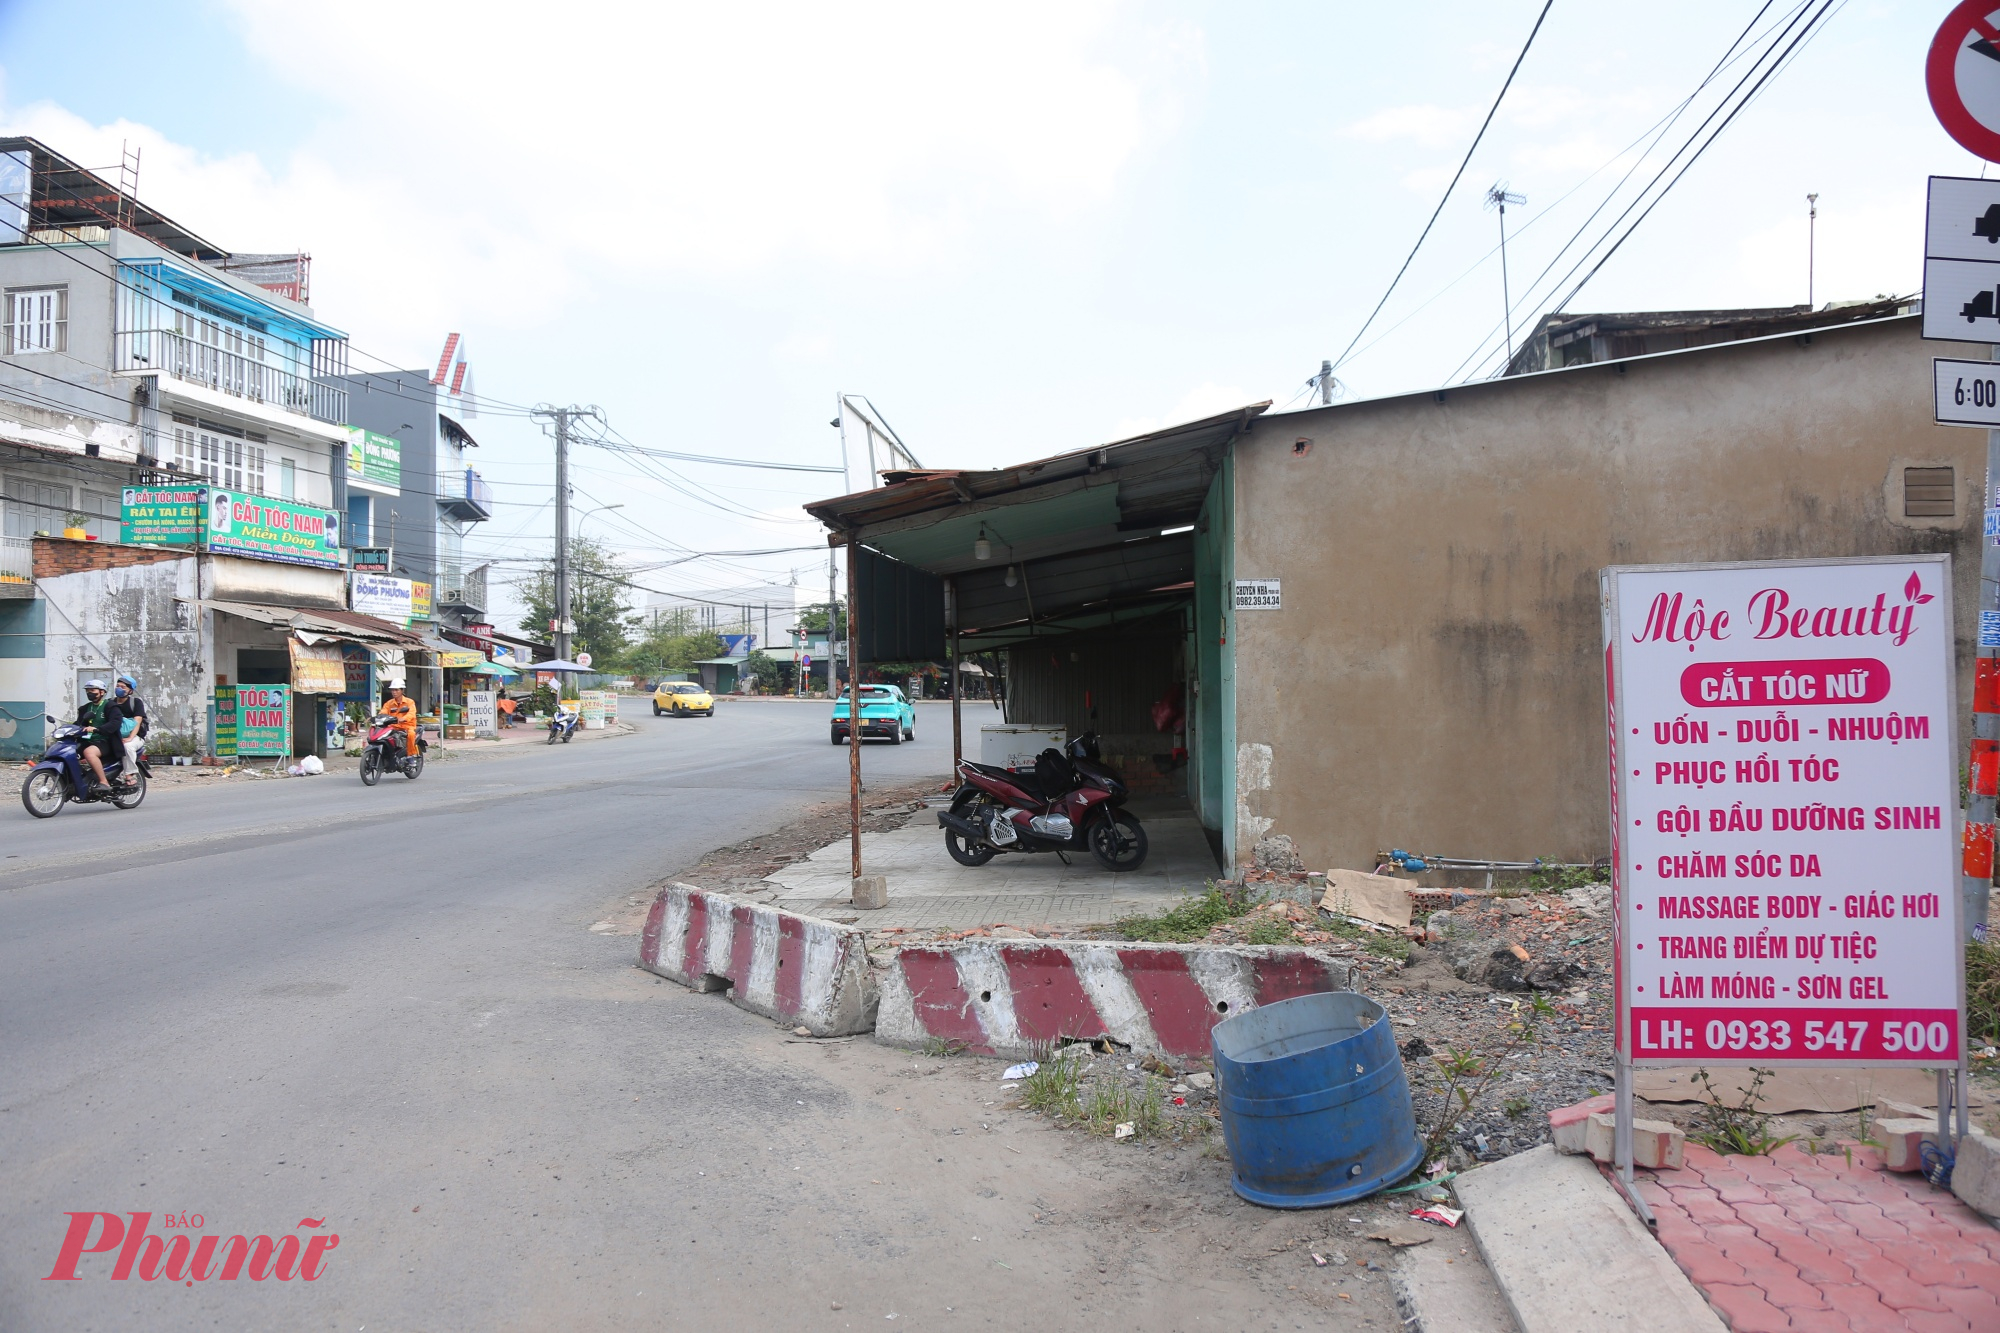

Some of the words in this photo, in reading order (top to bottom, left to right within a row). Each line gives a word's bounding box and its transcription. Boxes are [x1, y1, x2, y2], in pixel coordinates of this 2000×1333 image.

[1955, 377, 1996, 408] 6:00
[380, 446, 400, 463] PHƯƠNG
[135, 489, 153, 504] CẮT
[154, 489, 172, 504] TÓC
[174, 492, 197, 504] NAM
[130, 507, 155, 517] RÁY
[158, 507, 177, 517] TAI
[233, 498, 260, 524] CẮT
[264, 505, 290, 530] TÓC
[294, 513, 324, 536] NAM
[241, 525, 278, 541] Miền
[281, 531, 316, 549] Đông
[356, 582, 379, 595] ĐÔNG
[380, 586, 410, 599] PHƯƠNG
[476, 627, 491, 635] ANH
[1632, 591, 1732, 653] Mộc
[1748, 588, 1920, 647] Beauty
[479, 641, 491, 650] XE
[238, 686, 268, 707] TÓC
[1701, 668, 1753, 701] CẮT
[1762, 670, 1816, 700] TÓC
[1826, 668, 1869, 698] NỮ
[473, 692, 488, 702] NHÀ
[245, 710, 283, 728] NAM
[470, 704, 493, 715] THUỐC
[474, 717, 489, 727] TÂY
[1654, 713, 1709, 745] UỐN
[1736, 710, 1799, 743] DUỖI
[1828, 711, 1930, 745] NHUỘM
[238, 740, 248, 749] GỘI
[248, 739, 259, 748] ĐẦU
[1655, 760, 1726, 789] PHỤC
[1736, 751, 1780, 783] HỒI
[1788, 754, 1840, 783] TÓC
[1657, 804, 1701, 838] GỘI
[1709, 800, 1763, 832] ĐẦU
[1772, 802, 1865, 832] DƯỠNG
[1874, 806, 1941, 831] SINH
[1657, 851, 1727, 879] CHĂM
[1735, 850, 1781, 879] SÓC
[1790, 853, 1822, 878] DA
[1658, 895, 1760, 920] MASSAGE
[1767, 895, 1821, 919] BODY
[1844, 890, 1896, 919] GIÁC
[1903, 893, 1940, 919] HƠI
[1658, 935, 1727, 959] TRANG
[1733, 926, 1788, 959] ĐIỂM
[1795, 933, 1825, 965] DỰ
[1831, 931, 1878, 963] TIỆC
[1659, 971, 1705, 999] LÀM
[1711, 971, 1776, 1000] MÓNG
[1797, 974, 1842, 1000] SƠN
[1850, 975, 1889, 1000] GEL
[1640, 1020, 1693, 1049] LH:
[1705, 1020, 1791, 1050] 0933
[1804, 1020, 1868, 1051] 547
[1882, 1021, 1948, 1052] 500
